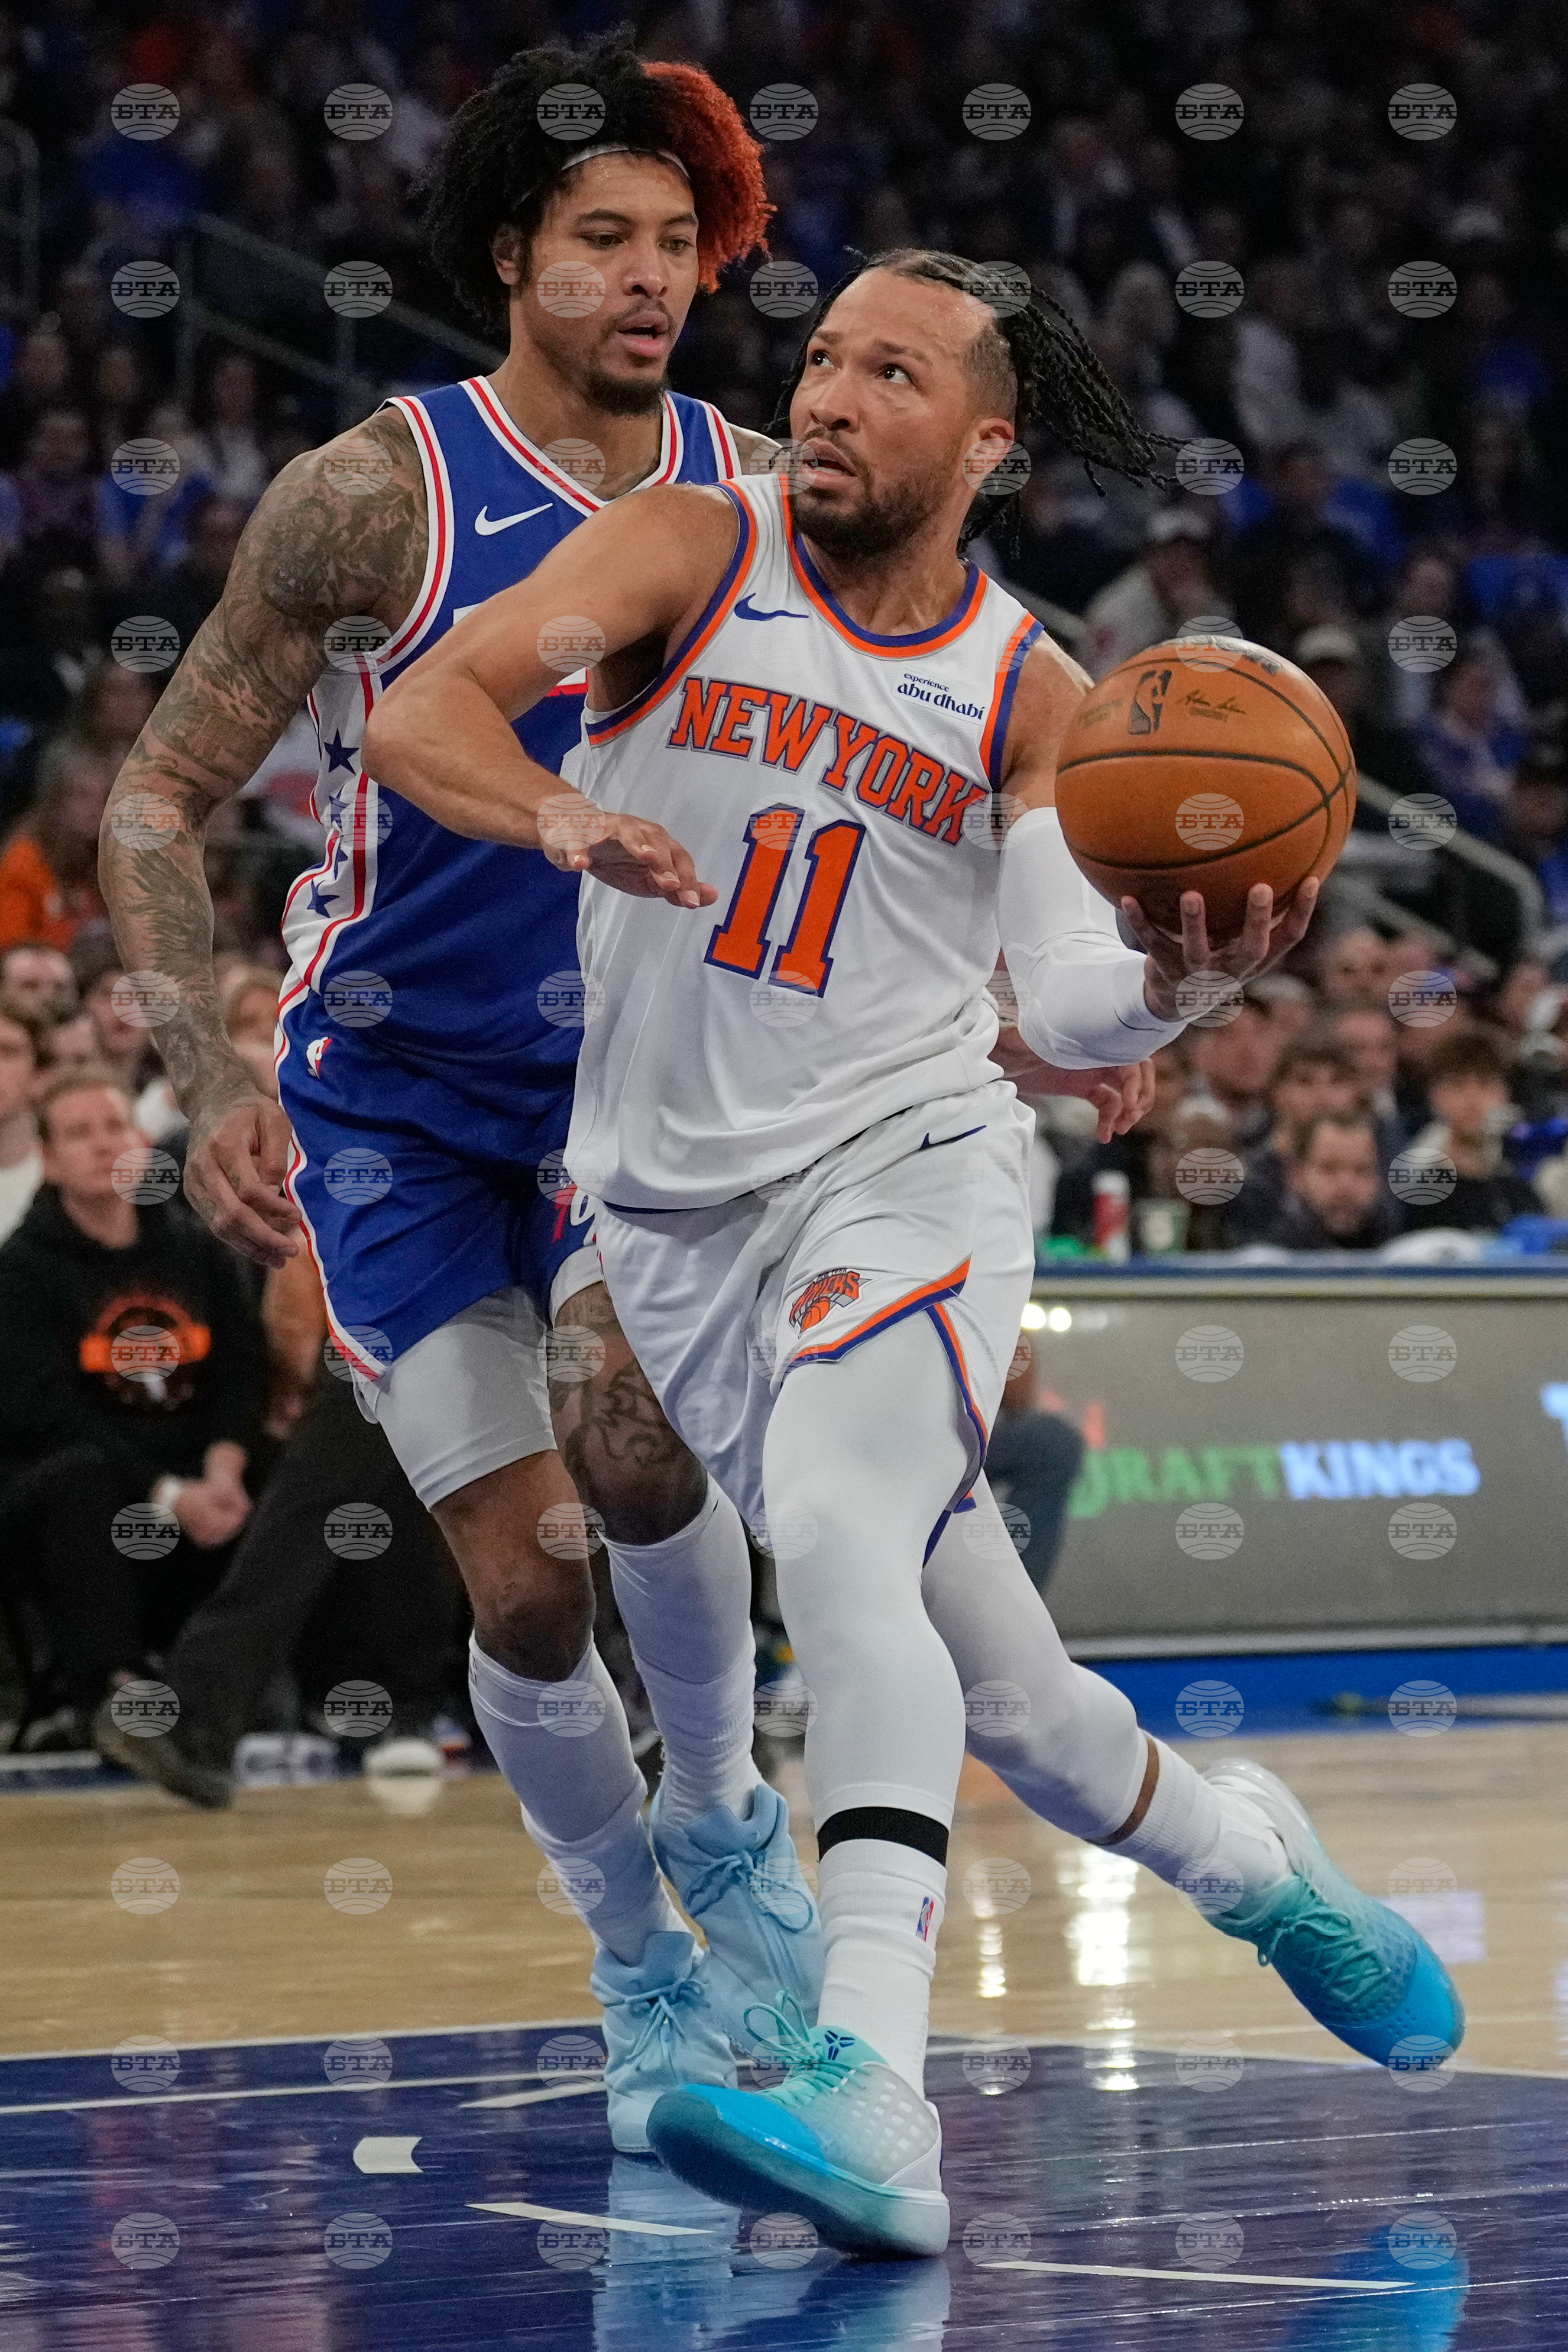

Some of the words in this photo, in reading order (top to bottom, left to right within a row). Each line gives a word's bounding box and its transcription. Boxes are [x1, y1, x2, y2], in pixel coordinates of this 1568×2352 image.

[897, 682, 932, 703] abu
[903, 673, 950, 692] experience
[666, 676, 832, 774] NEW
[819, 707, 992, 846] YORK
[704, 802, 867, 998] 11
